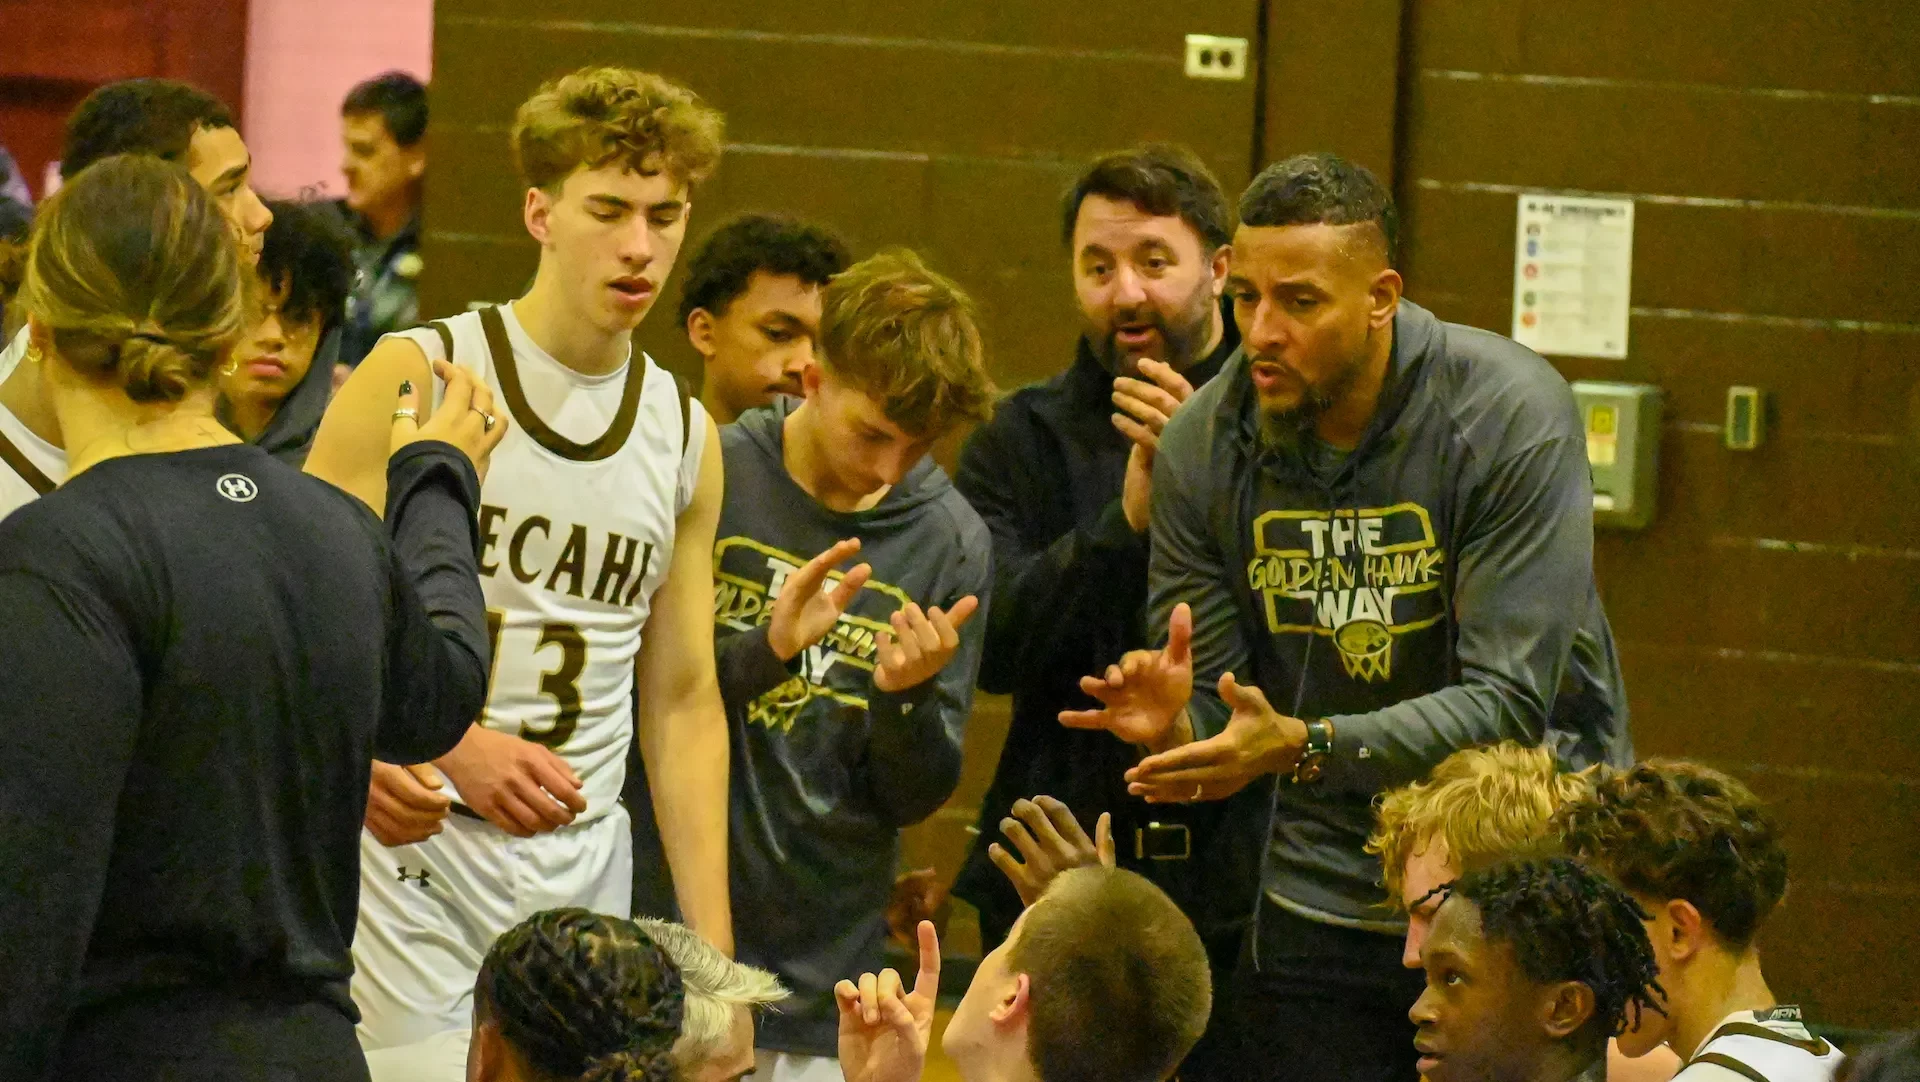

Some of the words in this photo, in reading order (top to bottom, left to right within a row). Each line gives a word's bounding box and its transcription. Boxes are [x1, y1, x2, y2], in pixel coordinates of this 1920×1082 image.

[478, 504, 654, 607] ECAHI
[1301, 517, 1383, 559] THE
[1247, 556, 1356, 592] GOLDEN
[1362, 549, 1444, 587] HAWK
[1307, 586, 1397, 630] WAY
